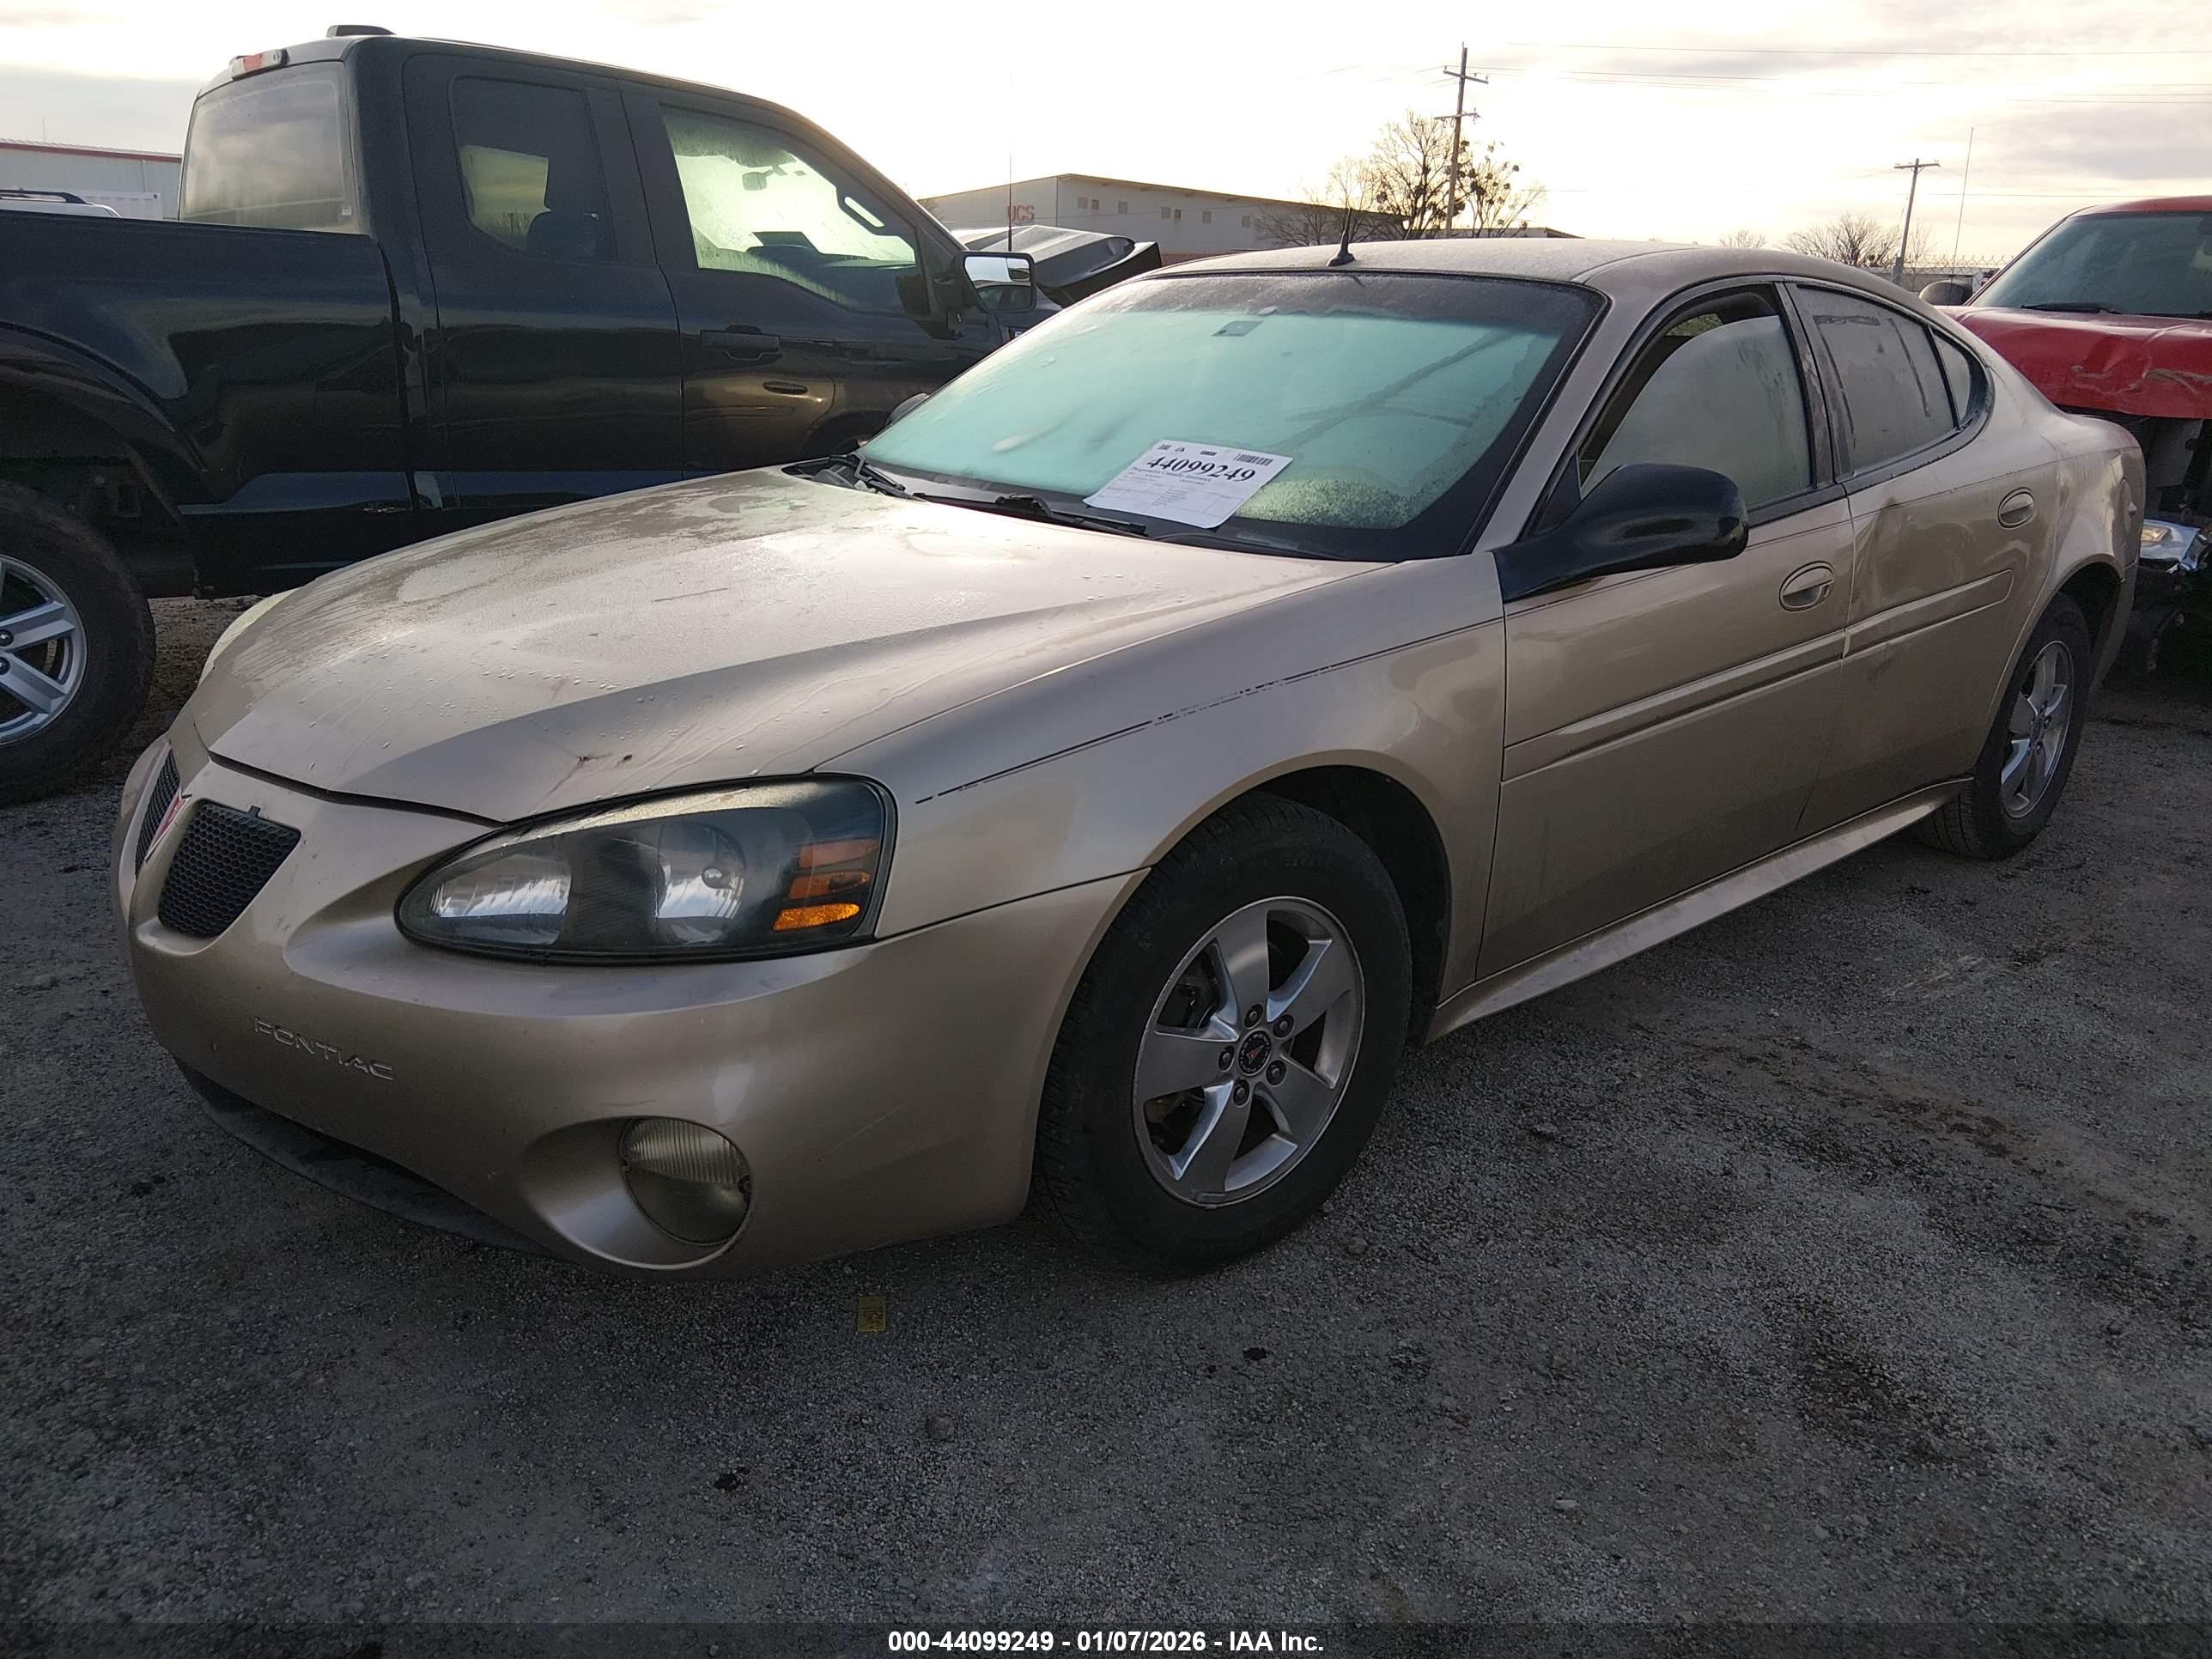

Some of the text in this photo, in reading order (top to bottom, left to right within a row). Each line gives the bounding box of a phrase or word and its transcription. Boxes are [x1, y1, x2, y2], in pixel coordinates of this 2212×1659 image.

[1006, 205, 1035, 221] UCS
[1146, 456, 1256, 482] 44099249
[252, 1016, 394, 1080] PONTIAC
